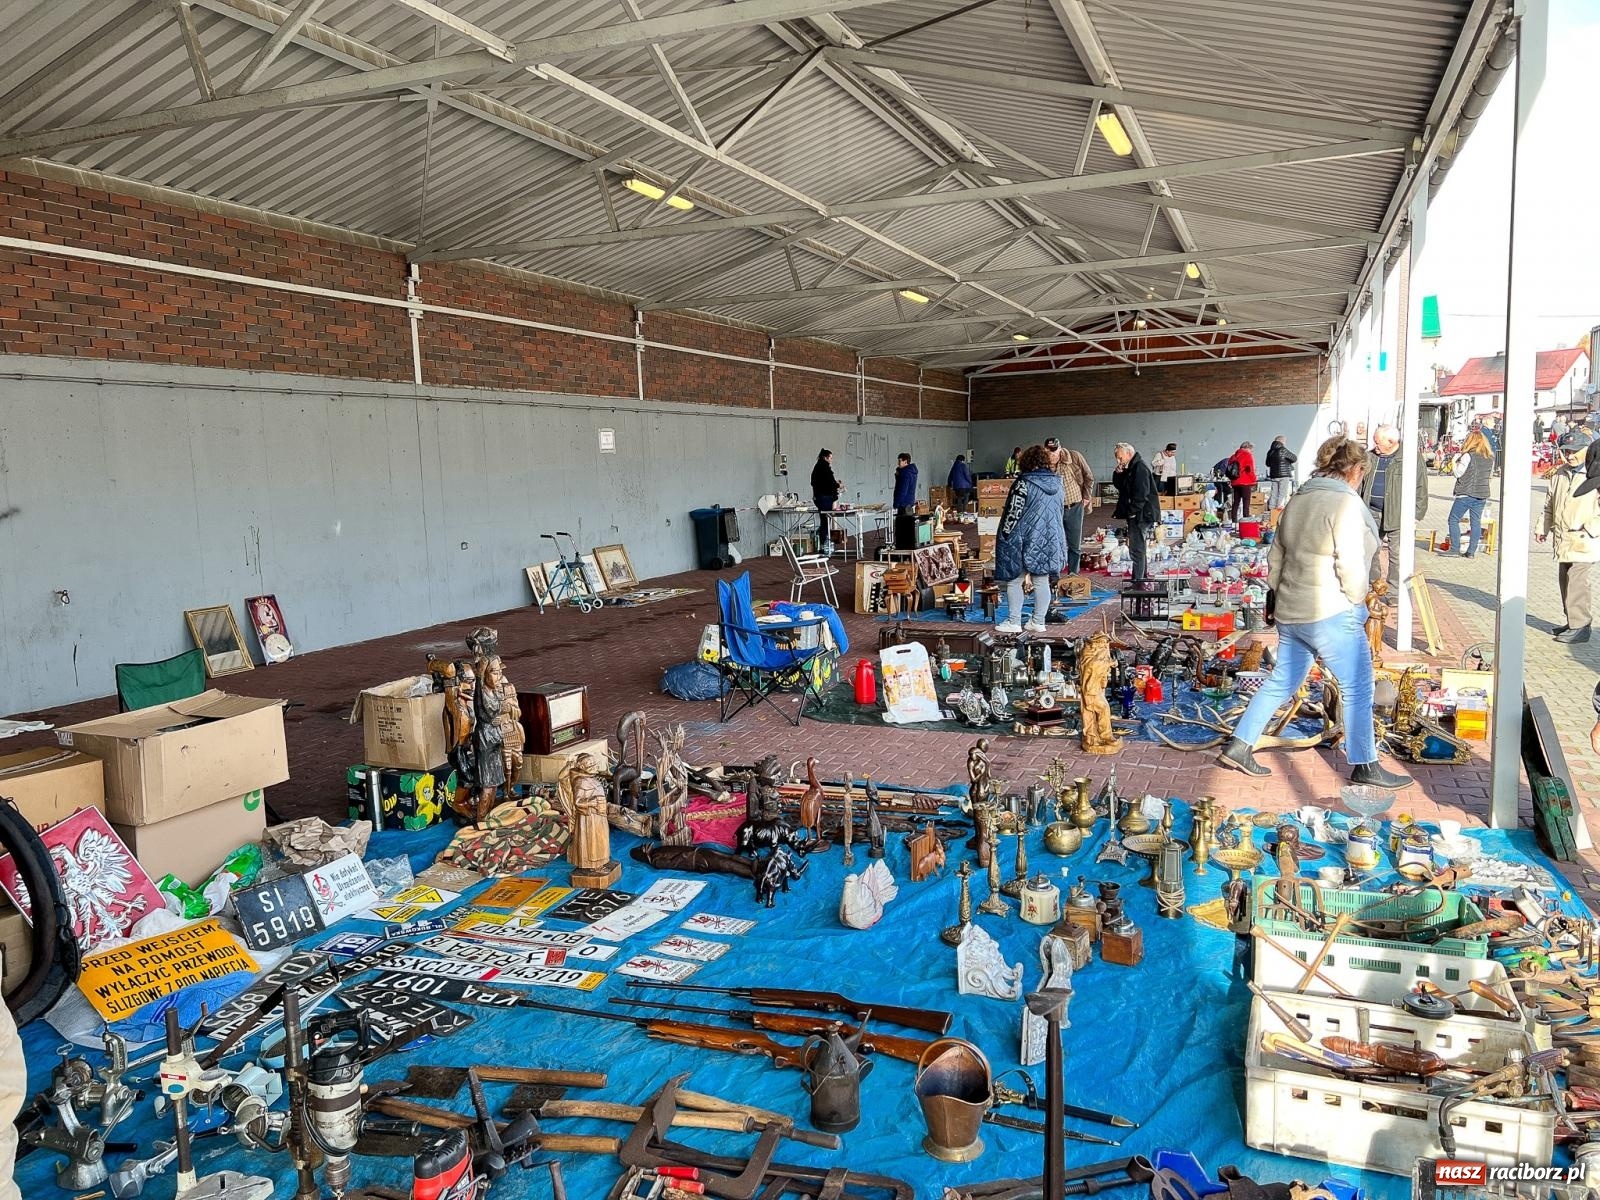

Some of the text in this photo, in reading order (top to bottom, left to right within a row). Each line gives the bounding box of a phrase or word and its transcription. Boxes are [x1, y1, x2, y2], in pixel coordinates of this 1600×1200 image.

[329, 871, 342, 882] Nie
[555, 890, 603, 914] KTE
[584, 892, 631, 919] 6376
[253, 906, 315, 946] 5919
[392, 925, 431, 937] BUKOWSKA
[81, 924, 217, 972] PRZED WEJŚCIEM
[111, 941, 206, 976] NA POMOST
[95, 945, 240, 999] WYŁĄCZYĆ PRZEWODY
[372, 973, 448, 996] 1097
[106, 987, 165, 1014] ŚLIZGOWE
[167, 982, 174, 993] Z
[175, 974, 198, 989] POD
[203, 993, 268, 1027] 8955
